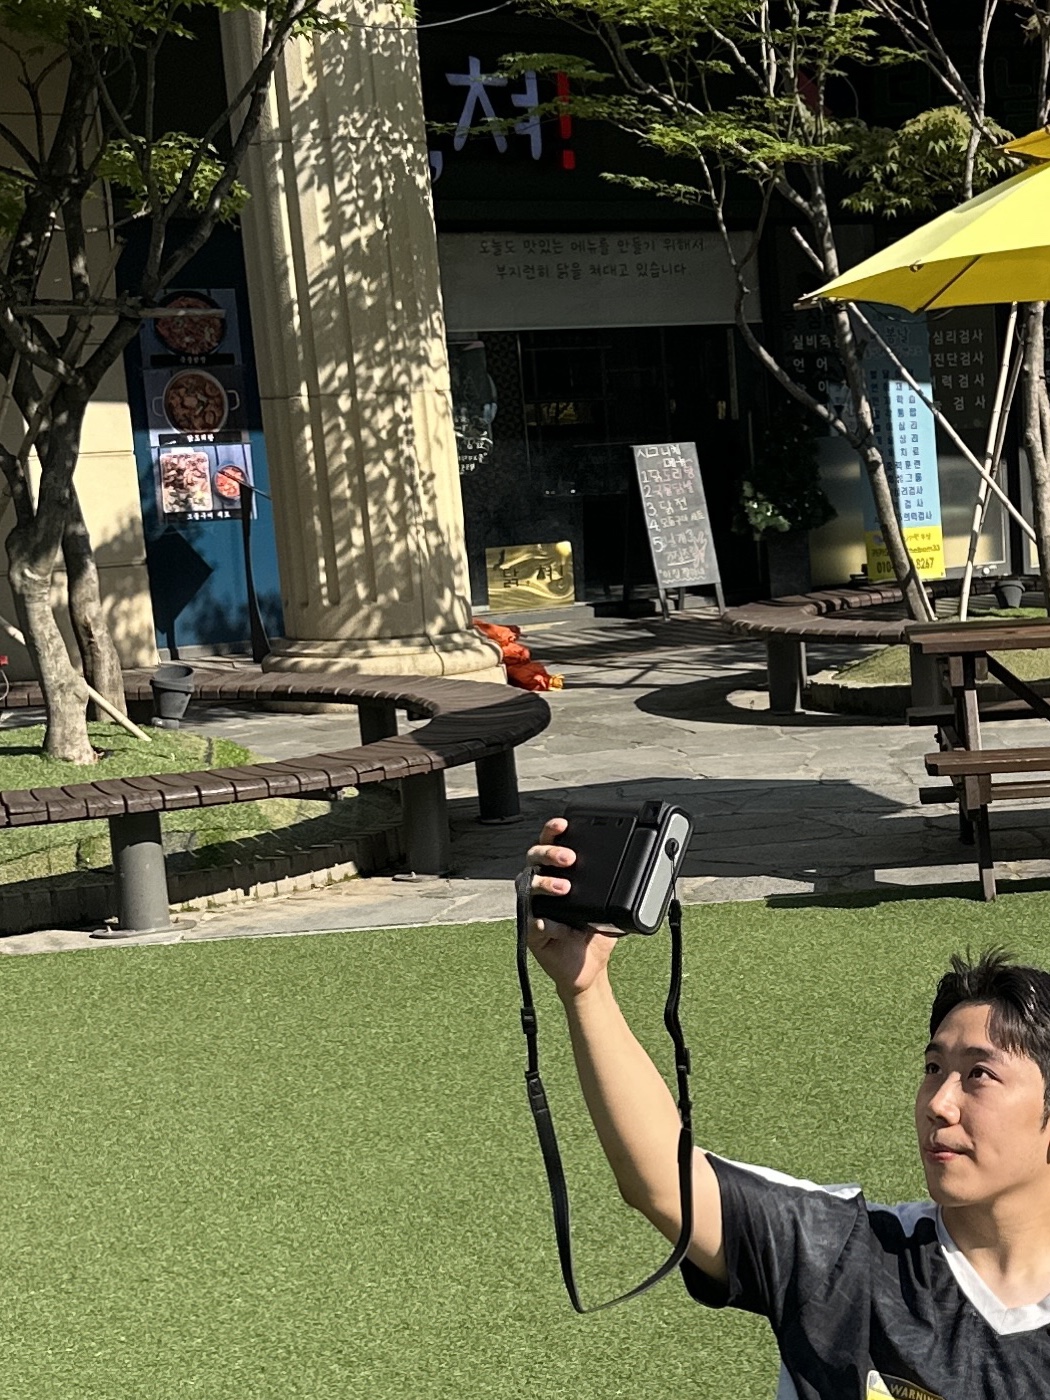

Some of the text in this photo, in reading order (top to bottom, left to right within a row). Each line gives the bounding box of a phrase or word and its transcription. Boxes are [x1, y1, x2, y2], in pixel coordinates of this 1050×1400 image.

[479, 239, 515, 256] 오늘도
[523, 238, 564, 255] 맛있는
[570, 238, 610, 256] 메뉴를
[663, 237, 704, 252] 위해서
[496, 264, 550, 280] 부지런히
[556, 262, 582, 280] 닭을
[636, 262, 687, 279] 있습니다
